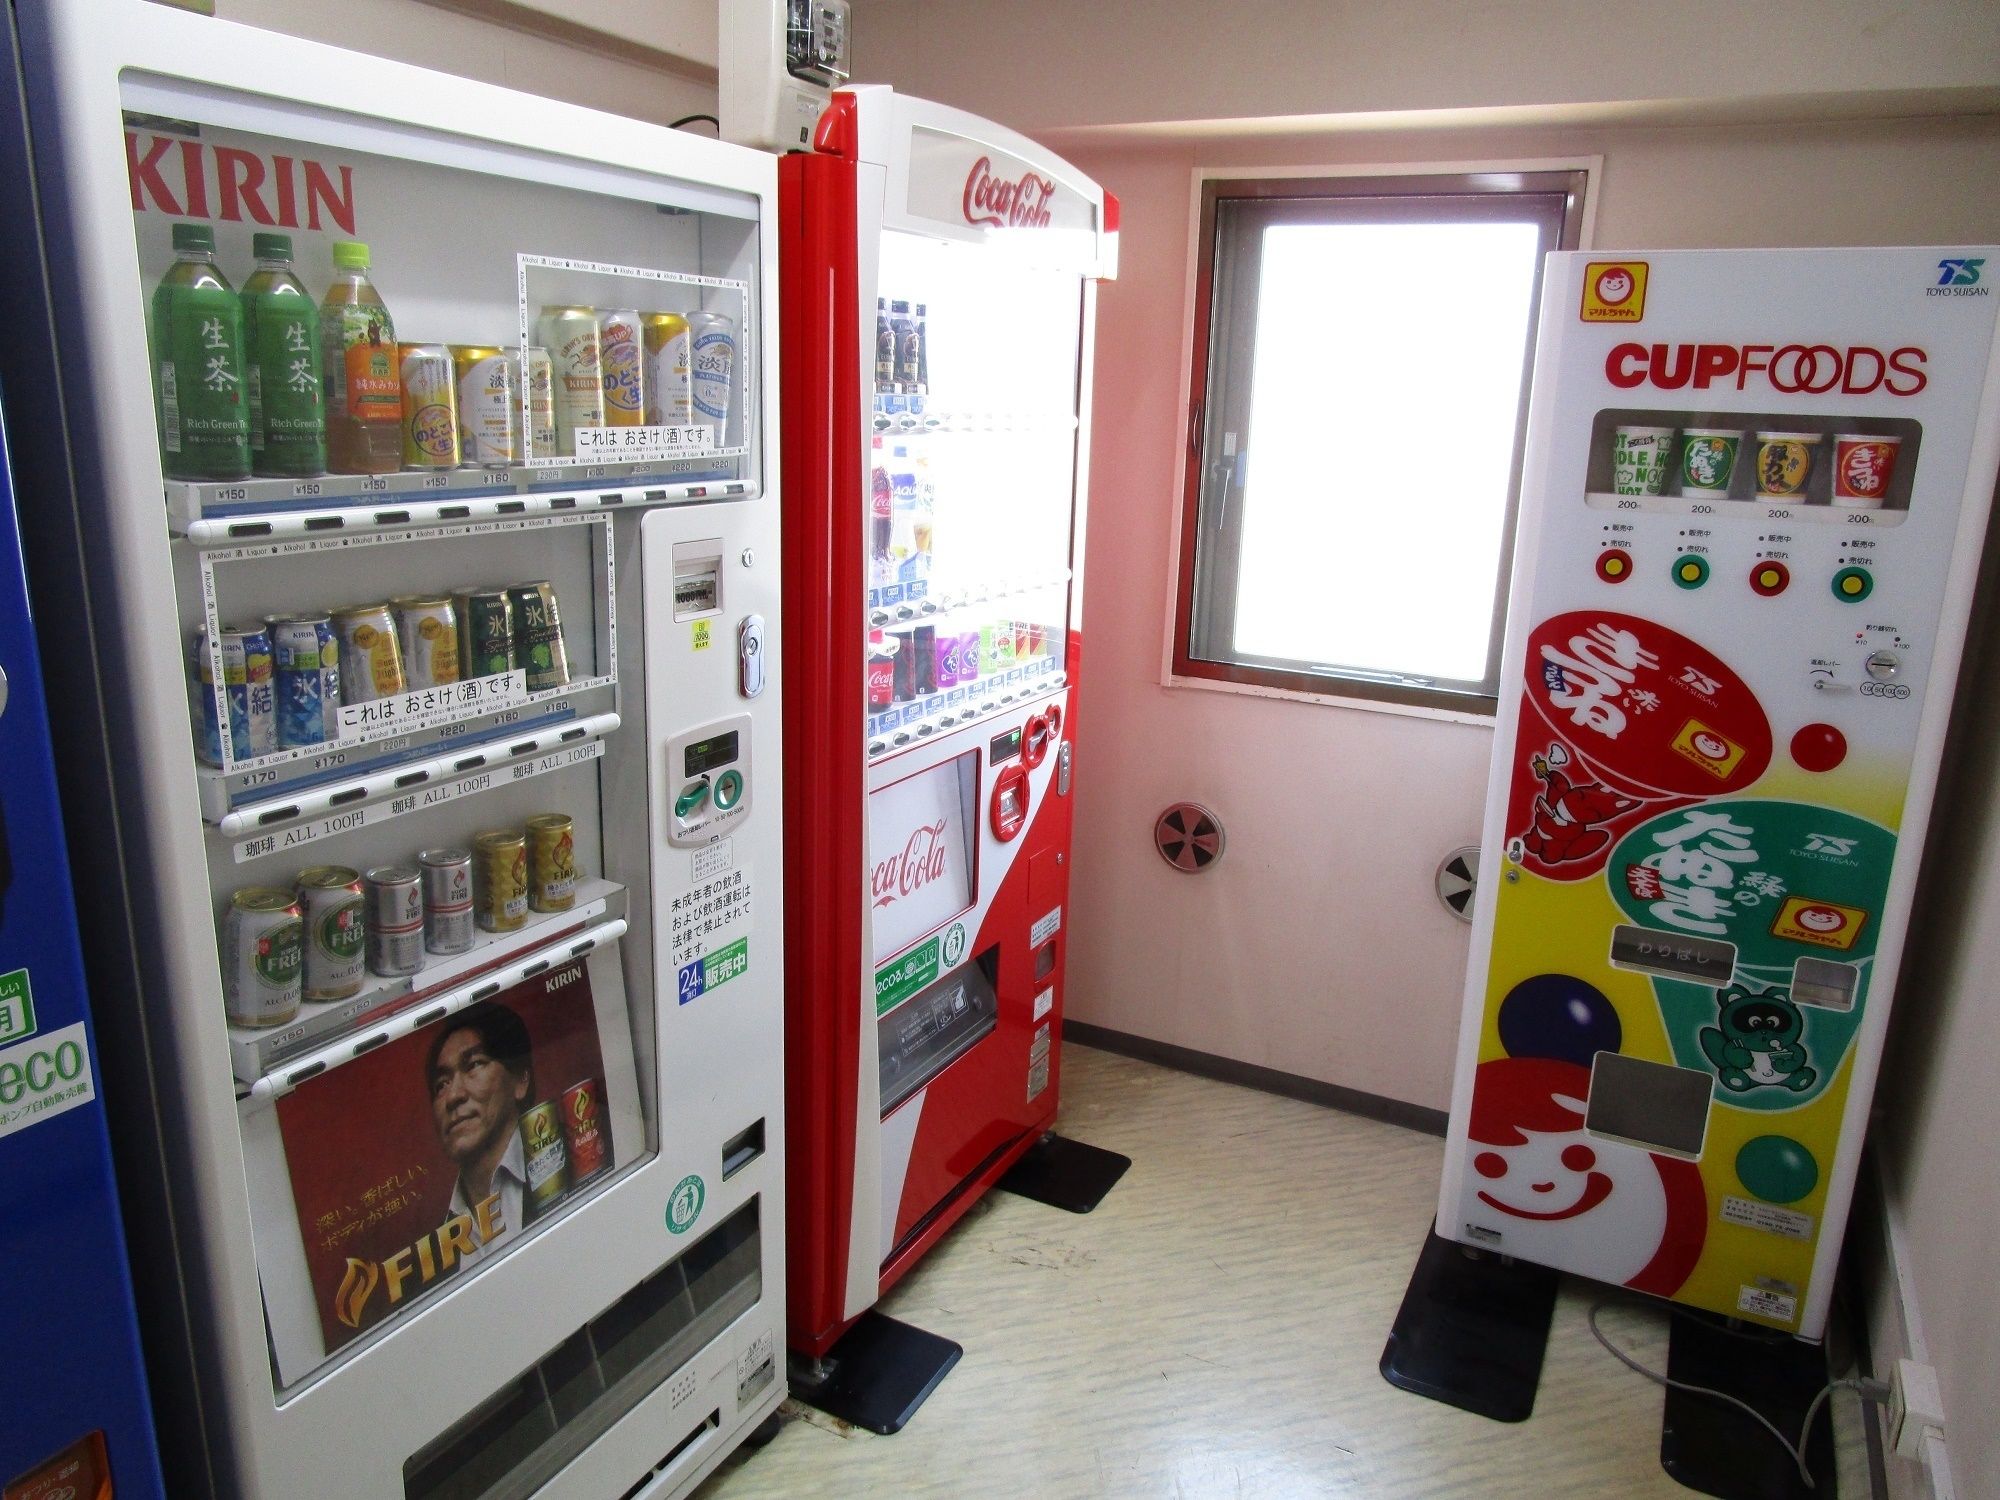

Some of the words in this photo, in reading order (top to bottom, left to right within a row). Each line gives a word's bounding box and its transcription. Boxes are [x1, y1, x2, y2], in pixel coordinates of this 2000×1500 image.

[123, 132, 356, 236] KIRIN
[1926, 287, 1951, 297] TOYO
[1953, 287, 1989, 297] SUISAN
[1588, 307, 1637, 318] マルちゃん
[201, 318, 239, 393] 生茶
[286, 322, 319, 394] 生茶
[569, 379, 597, 389] KIRIN
[187, 418, 209, 429] Rich
[211, 419, 238, 430] Green
[271, 418, 293, 429] Rich
[580, 429, 618, 447] これは
[218, 488, 245, 500] ¥150
[296, 484, 321, 496] ¥150
[363, 480, 387, 491] ¥150
[426, 477, 447, 488] ¥150
[207, 551, 231, 561] Alkohol
[247, 548, 267, 557] Liquor
[284, 543, 305, 553] Alkohol
[320, 540, 338, 549] Liquor
[352, 535, 373, 544] Alkohol
[1610, 540, 1631, 548] 売切れ
[1687, 545, 1709, 553] 売切れ
[1765, 551, 1788, 559] 売切れ
[1848, 557, 1872, 565] 売切れ
[293, 632, 316, 640] KIRIN
[205, 571, 213, 597] Alkohol
[209, 614, 217, 637] Liquor
[222, 734, 231, 759] Alkohol
[1667, 675, 1690, 693] TOYO
[1689, 688, 1719, 709] SUISAN
[344, 701, 395, 727] これは
[231, 761, 254, 773] Alkohol
[268, 753, 289, 765] Liquor
[303, 745, 325, 756] Alkohol
[338, 739, 356, 749] Liquor
[369, 731, 389, 741] Alkohol
[400, 724, 417, 733] Liquor
[243, 770, 277, 786] ¥170
[314, 754, 346, 769] ¥170
[384, 739, 407, 751] 220円
[440, 724, 466, 737] ¥220
[245, 835, 275, 859] 珈琲
[284, 824, 318, 844] ALL
[323, 810, 366, 835] 100円
[391, 794, 417, 816] 珈琲
[423, 784, 451, 806] ALL
[456, 774, 492, 796] 100円
[512, 762, 536, 781] 珈琲
[539, 753, 563, 771] ALL
[566, 744, 598, 765] 100円
[671, 870, 742, 913] 未成年者の飲酒
[672, 883, 751, 932] および飲酒運転は
[672, 901, 751, 950] 法律で禁止されて
[673, 941, 708, 967] います。
[1638, 941, 1710, 964] わりばし
[546, 966, 583, 994] KIRIN
[705, 952, 746, 989] 販売中
[381, 1189, 508, 1303] FIRE
